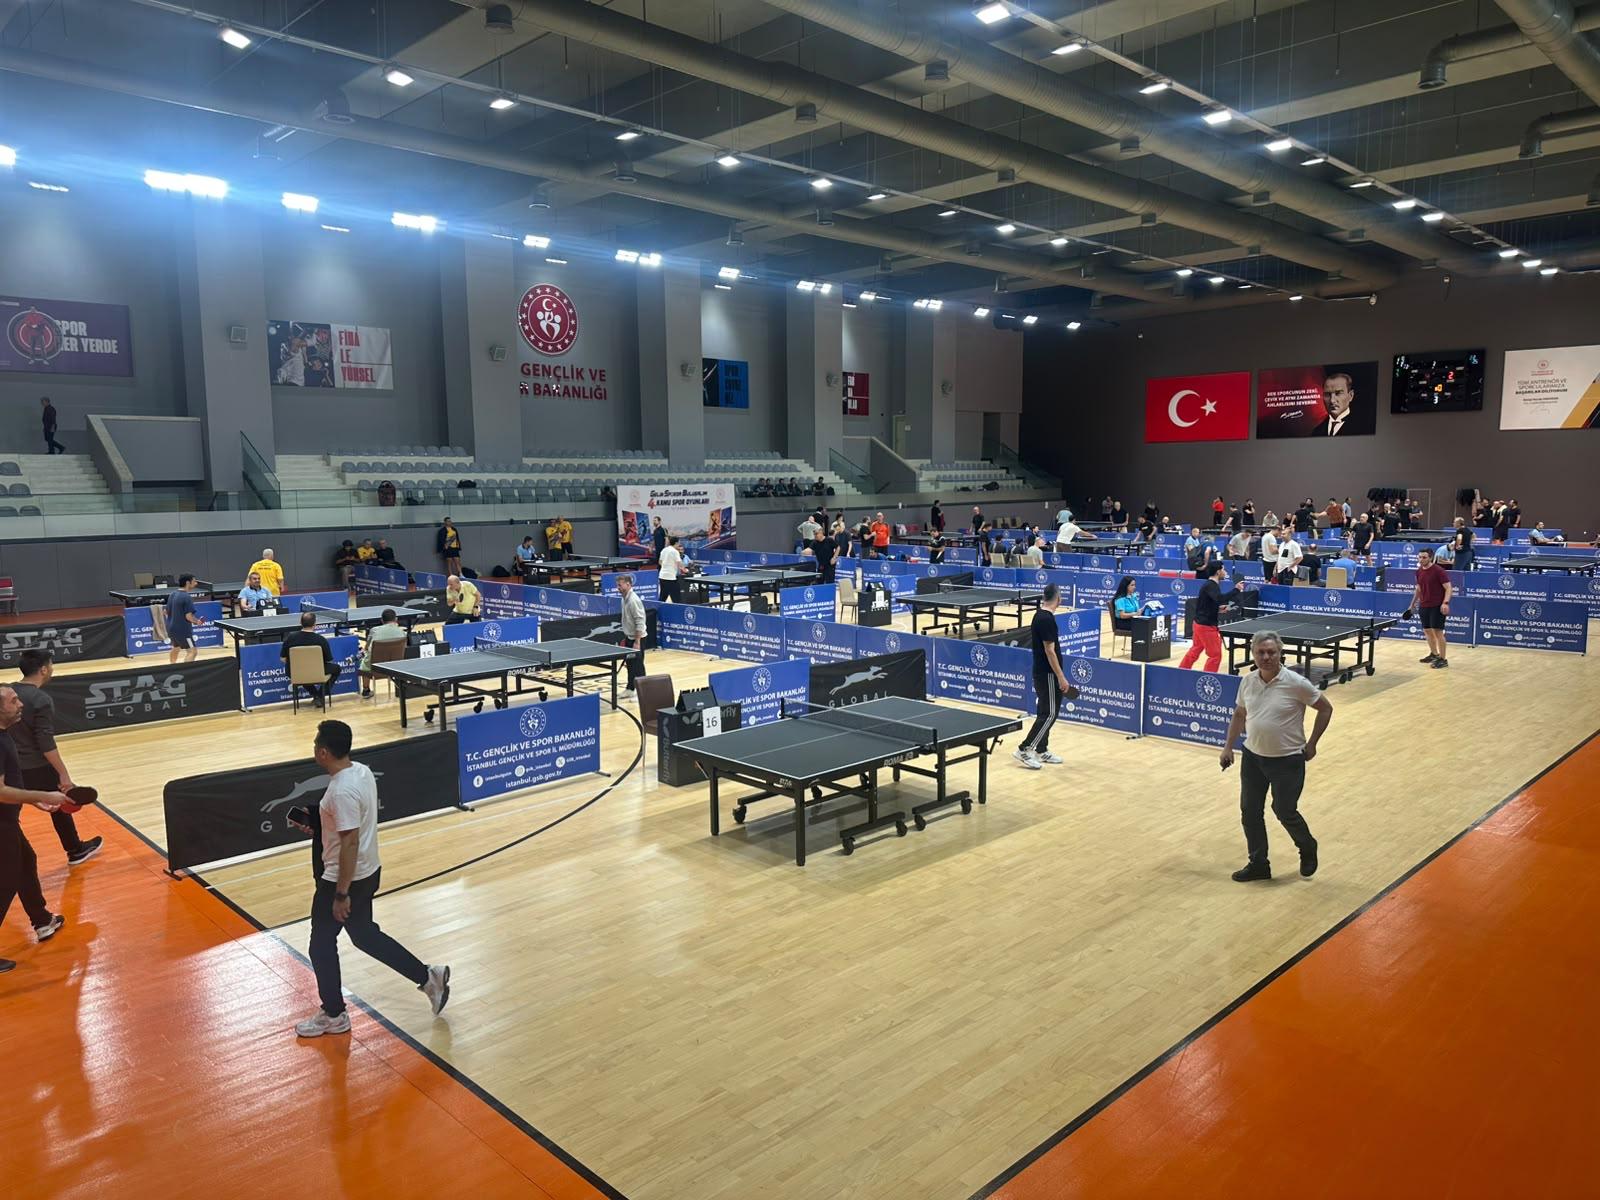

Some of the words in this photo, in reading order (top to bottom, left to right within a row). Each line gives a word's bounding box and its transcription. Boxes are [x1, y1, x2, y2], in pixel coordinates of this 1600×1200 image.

[80, 338, 118, 354] YERDE
[341, 349, 352, 363] LE
[341, 366, 376, 382] YÜKSEL
[521, 363, 584, 382] GENÇLİK
[589, 368, 606, 381] VE
[533, 383, 607, 400] BAKANLIĞI
[2, 628, 83, 649] STAG
[261, 667, 286, 678] GENÇLİ
[948, 664, 970, 675] GENÇLİK
[979, 669, 993, 677] SPOR
[994, 671, 1025, 682] BAKANLIĞI
[85, 674, 187, 704] STAG
[752, 695, 760, 703] VE
[760, 693, 776, 702] SPOR
[776, 686, 806, 698] BAKANLIĞI
[1081, 685, 1098, 695] SPOR
[1098, 688, 1135, 701] BAKANLIĞI
[85, 700, 188, 719] GLOBAL
[1148, 695, 1162, 704] T.C.
[1163, 697, 1195, 710] GENÇLİK
[1196, 702, 1206, 711] VE
[1206, 704, 1227, 715] SPOR
[1148, 704, 1175, 715] İSTANBUL
[1175, 709, 1200, 719] GENÇLİK
[706, 717, 718, 728] 16
[1059, 712, 1105, 724] stanbul.gsb.gov.tr
[466, 751, 482, 762] T.C.
[482, 742, 519, 758] GENÇLİK
[520, 740, 530, 750] VE
[531, 737, 553, 748] SPOR
[554, 726, 596, 743] BAKANLIĞI
[466, 760, 498, 772] İSTANBUL
[498, 753, 525, 763] GENÇLİK
[525, 751, 535, 759] VE
[535, 748, 551, 757] SPOR
[558, 738, 596, 752] MÜDÜRLÜĞÜ
